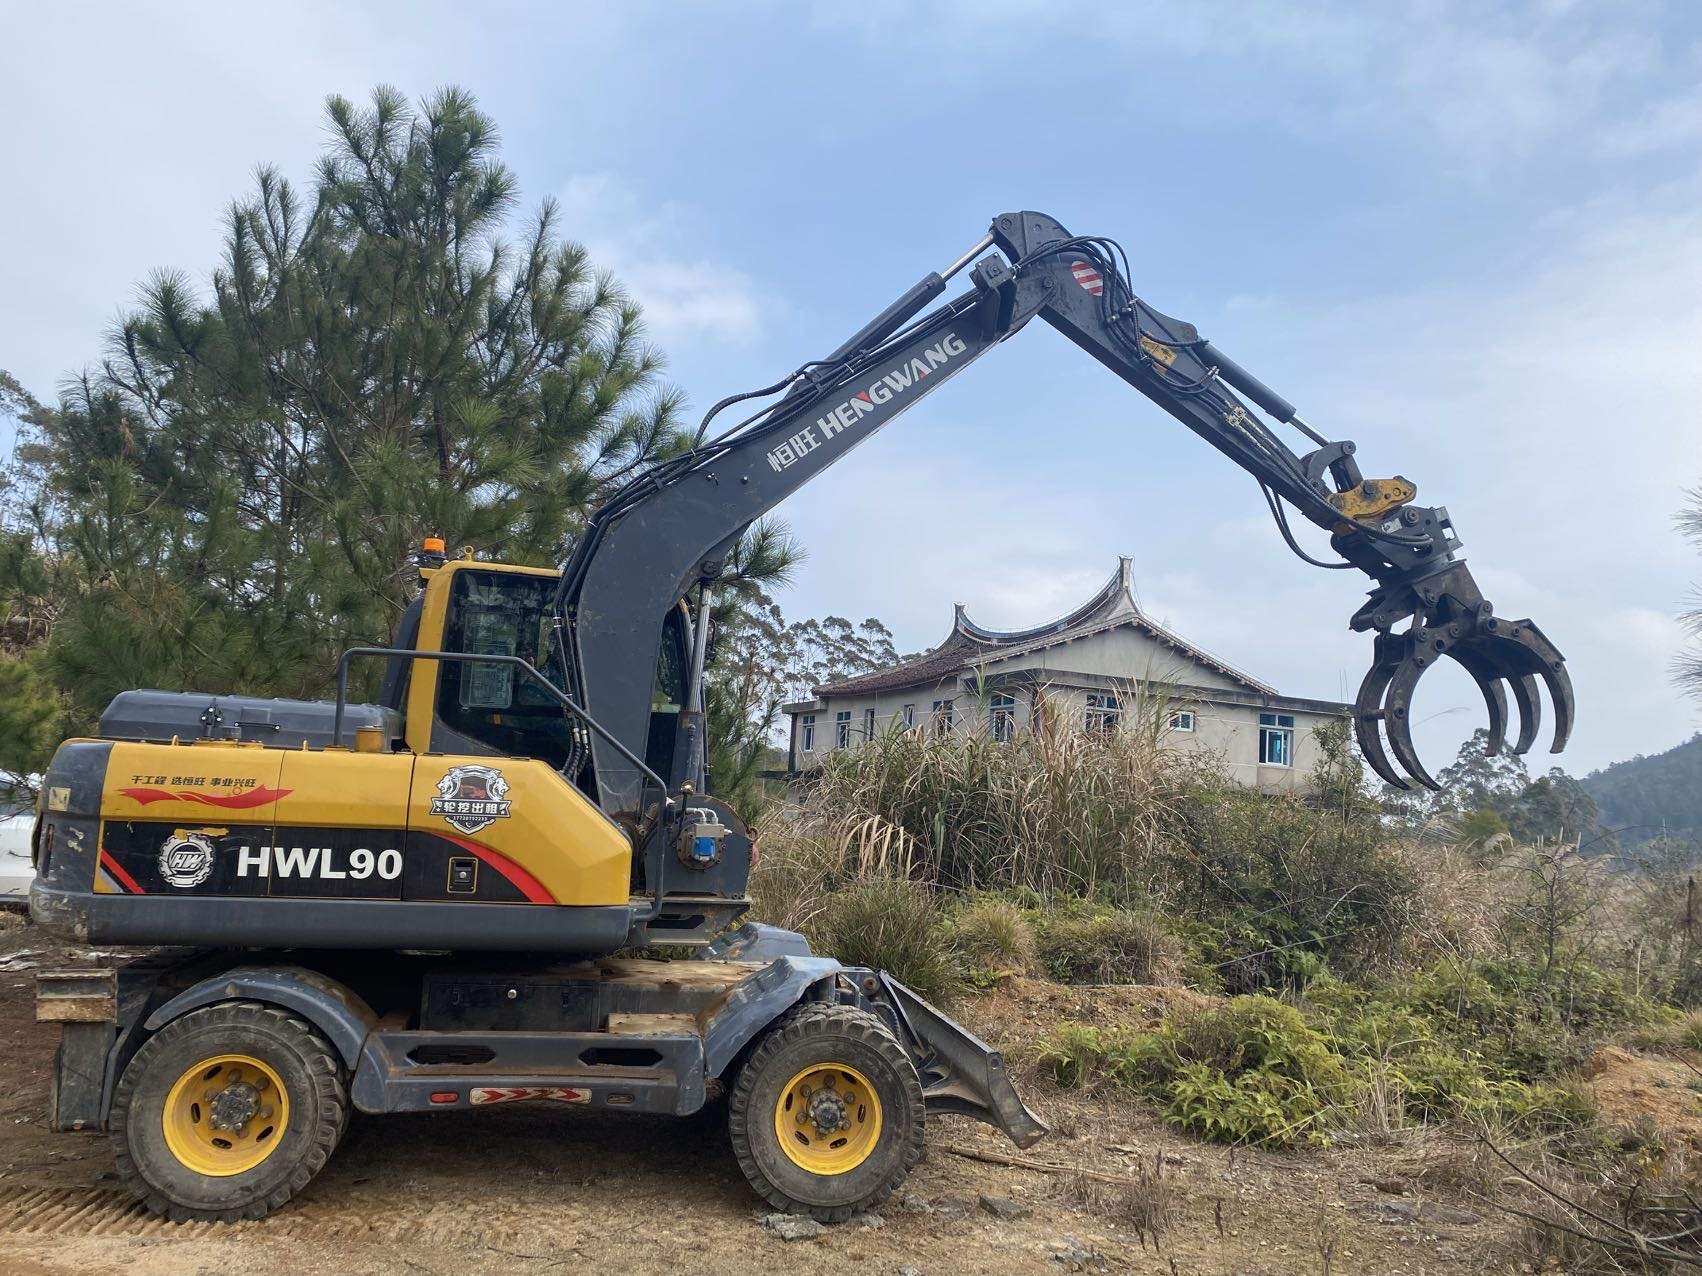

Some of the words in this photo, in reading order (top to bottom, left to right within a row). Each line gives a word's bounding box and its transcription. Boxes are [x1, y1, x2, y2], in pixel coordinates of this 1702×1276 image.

[766, 426, 822, 473] 恒旺
[816, 333, 967, 440] HENGWANG
[171, 776, 206, 786] 选恒旺
[209, 777, 257, 788] 事业兴旺
[443, 801, 498, 814] 轮挖出租
[237, 846, 403, 880] HWL90
